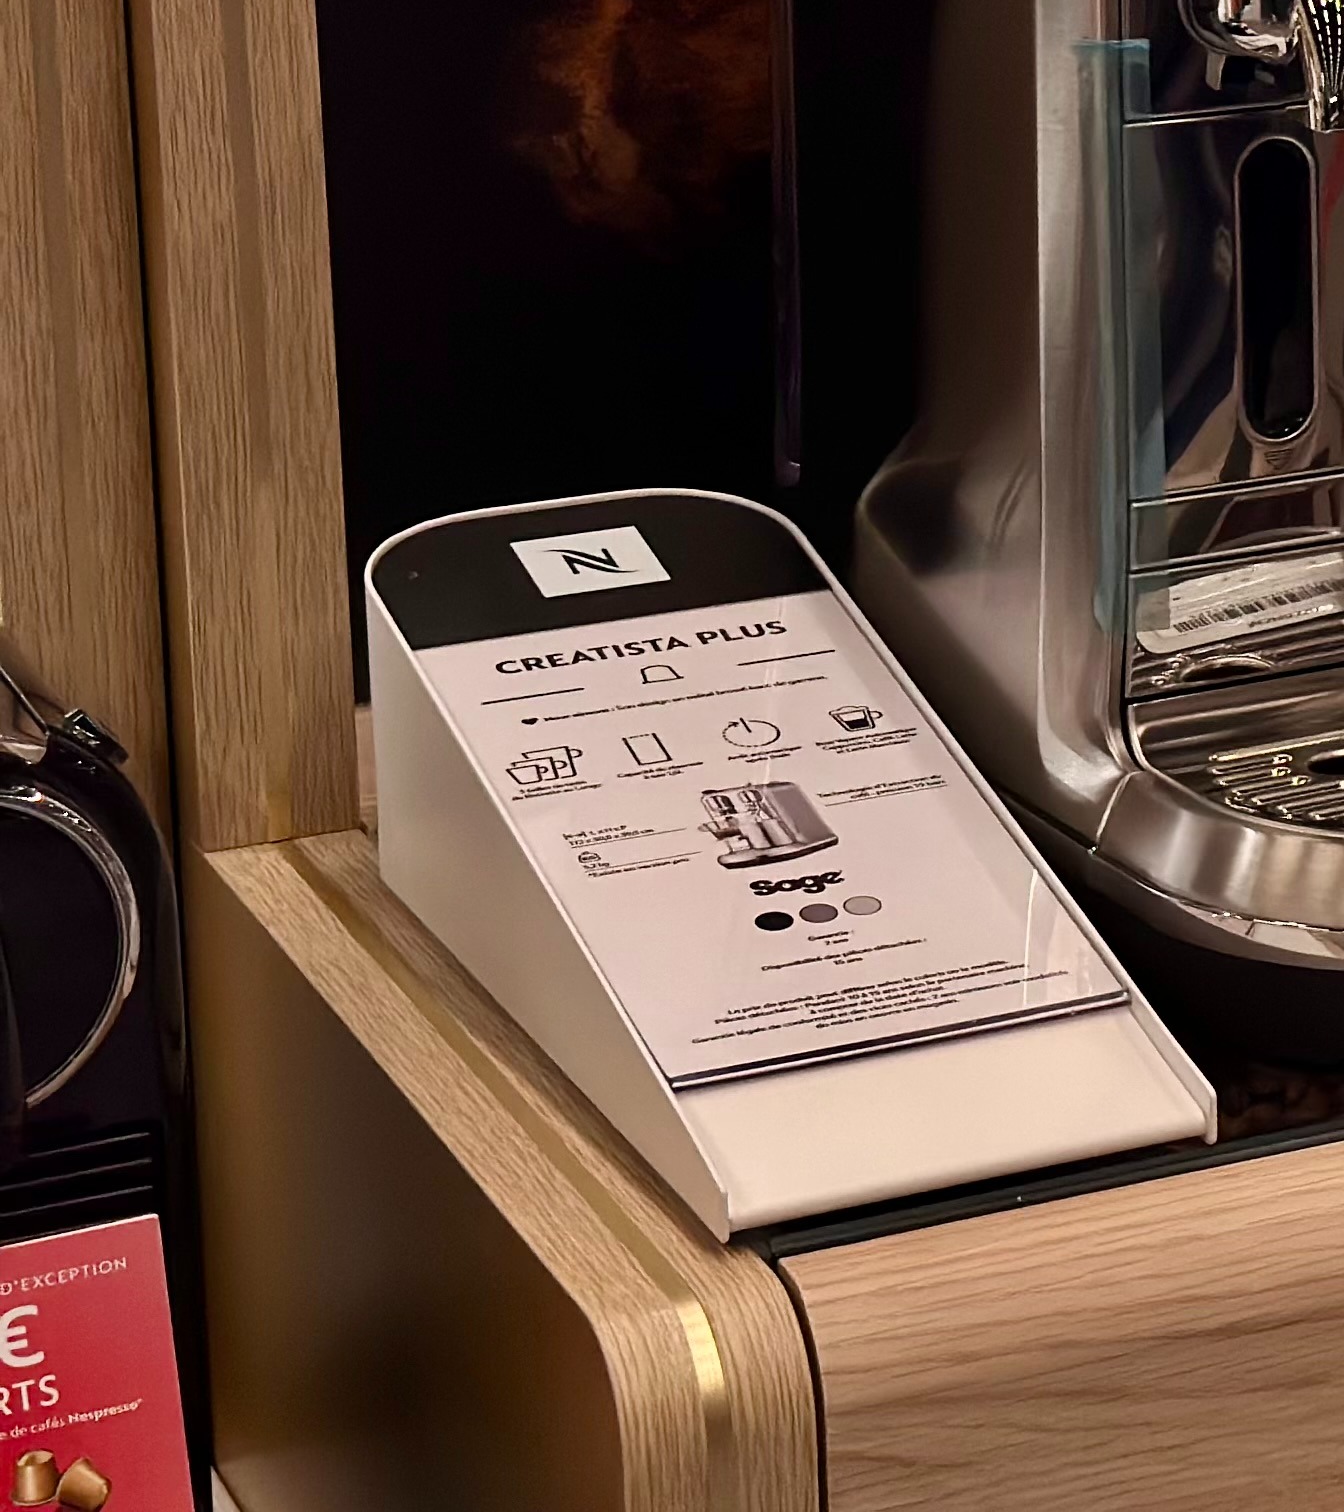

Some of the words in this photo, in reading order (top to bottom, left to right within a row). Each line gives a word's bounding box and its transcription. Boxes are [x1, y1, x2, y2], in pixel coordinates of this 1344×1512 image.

[495, 635, 691, 675] CREATISTA
[695, 620, 787, 646] PLUS
[0, 1256, 127, 1296] D'EXCEPTION
